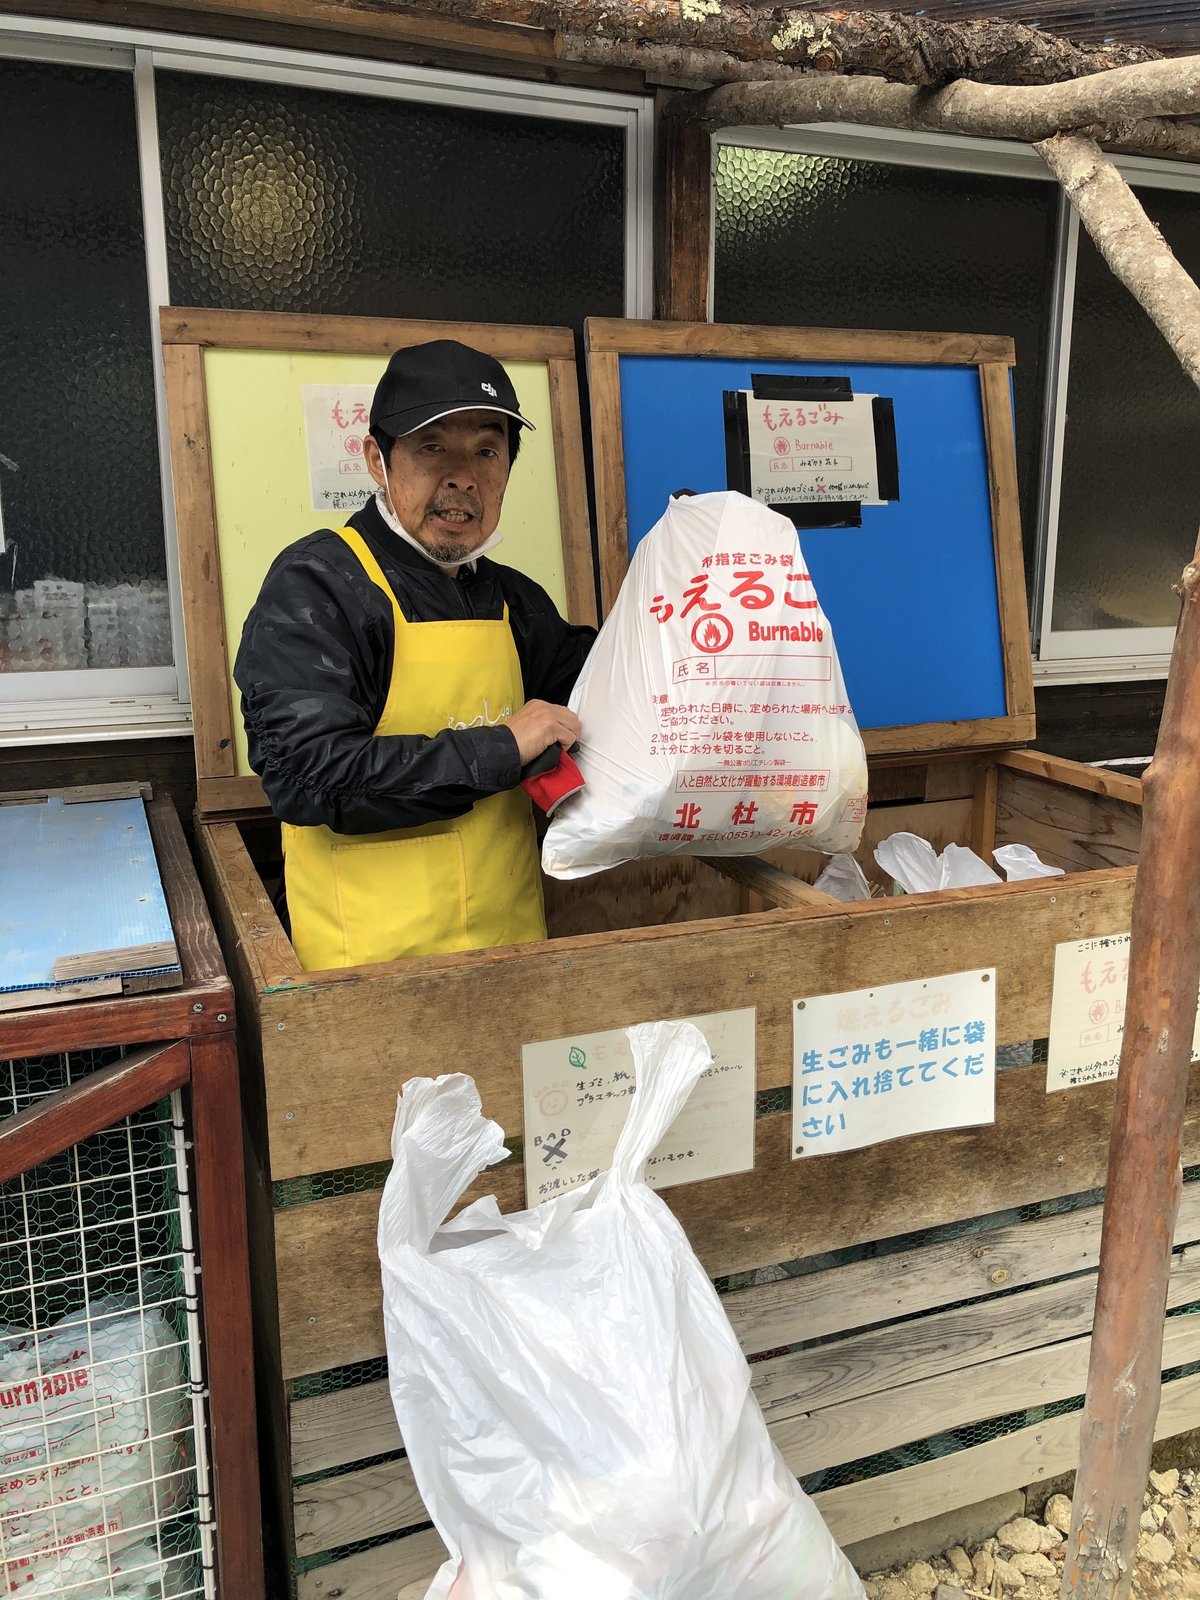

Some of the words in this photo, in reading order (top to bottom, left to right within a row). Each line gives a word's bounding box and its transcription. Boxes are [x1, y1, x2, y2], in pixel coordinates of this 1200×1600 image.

[763, 403, 844, 431] もえるごみ
[795, 440, 833, 451] Burnable
[343, 463, 362, 472] 氏名
[702, 552, 794, 569] 市指定ごみ袋
[748, 621, 823, 643] Burnable
[677, 662, 710, 677] 氏名
[679, 774, 826, 788] 人と自然と文化が躍動する環境創造都市
[801, 1020, 986, 1075] 生ごみも一緒に袋
[803, 1053, 985, 1106] に入れ捨ててくだ
[802, 1113, 846, 1138] さい
[534, 1128, 571, 1147] BAD
